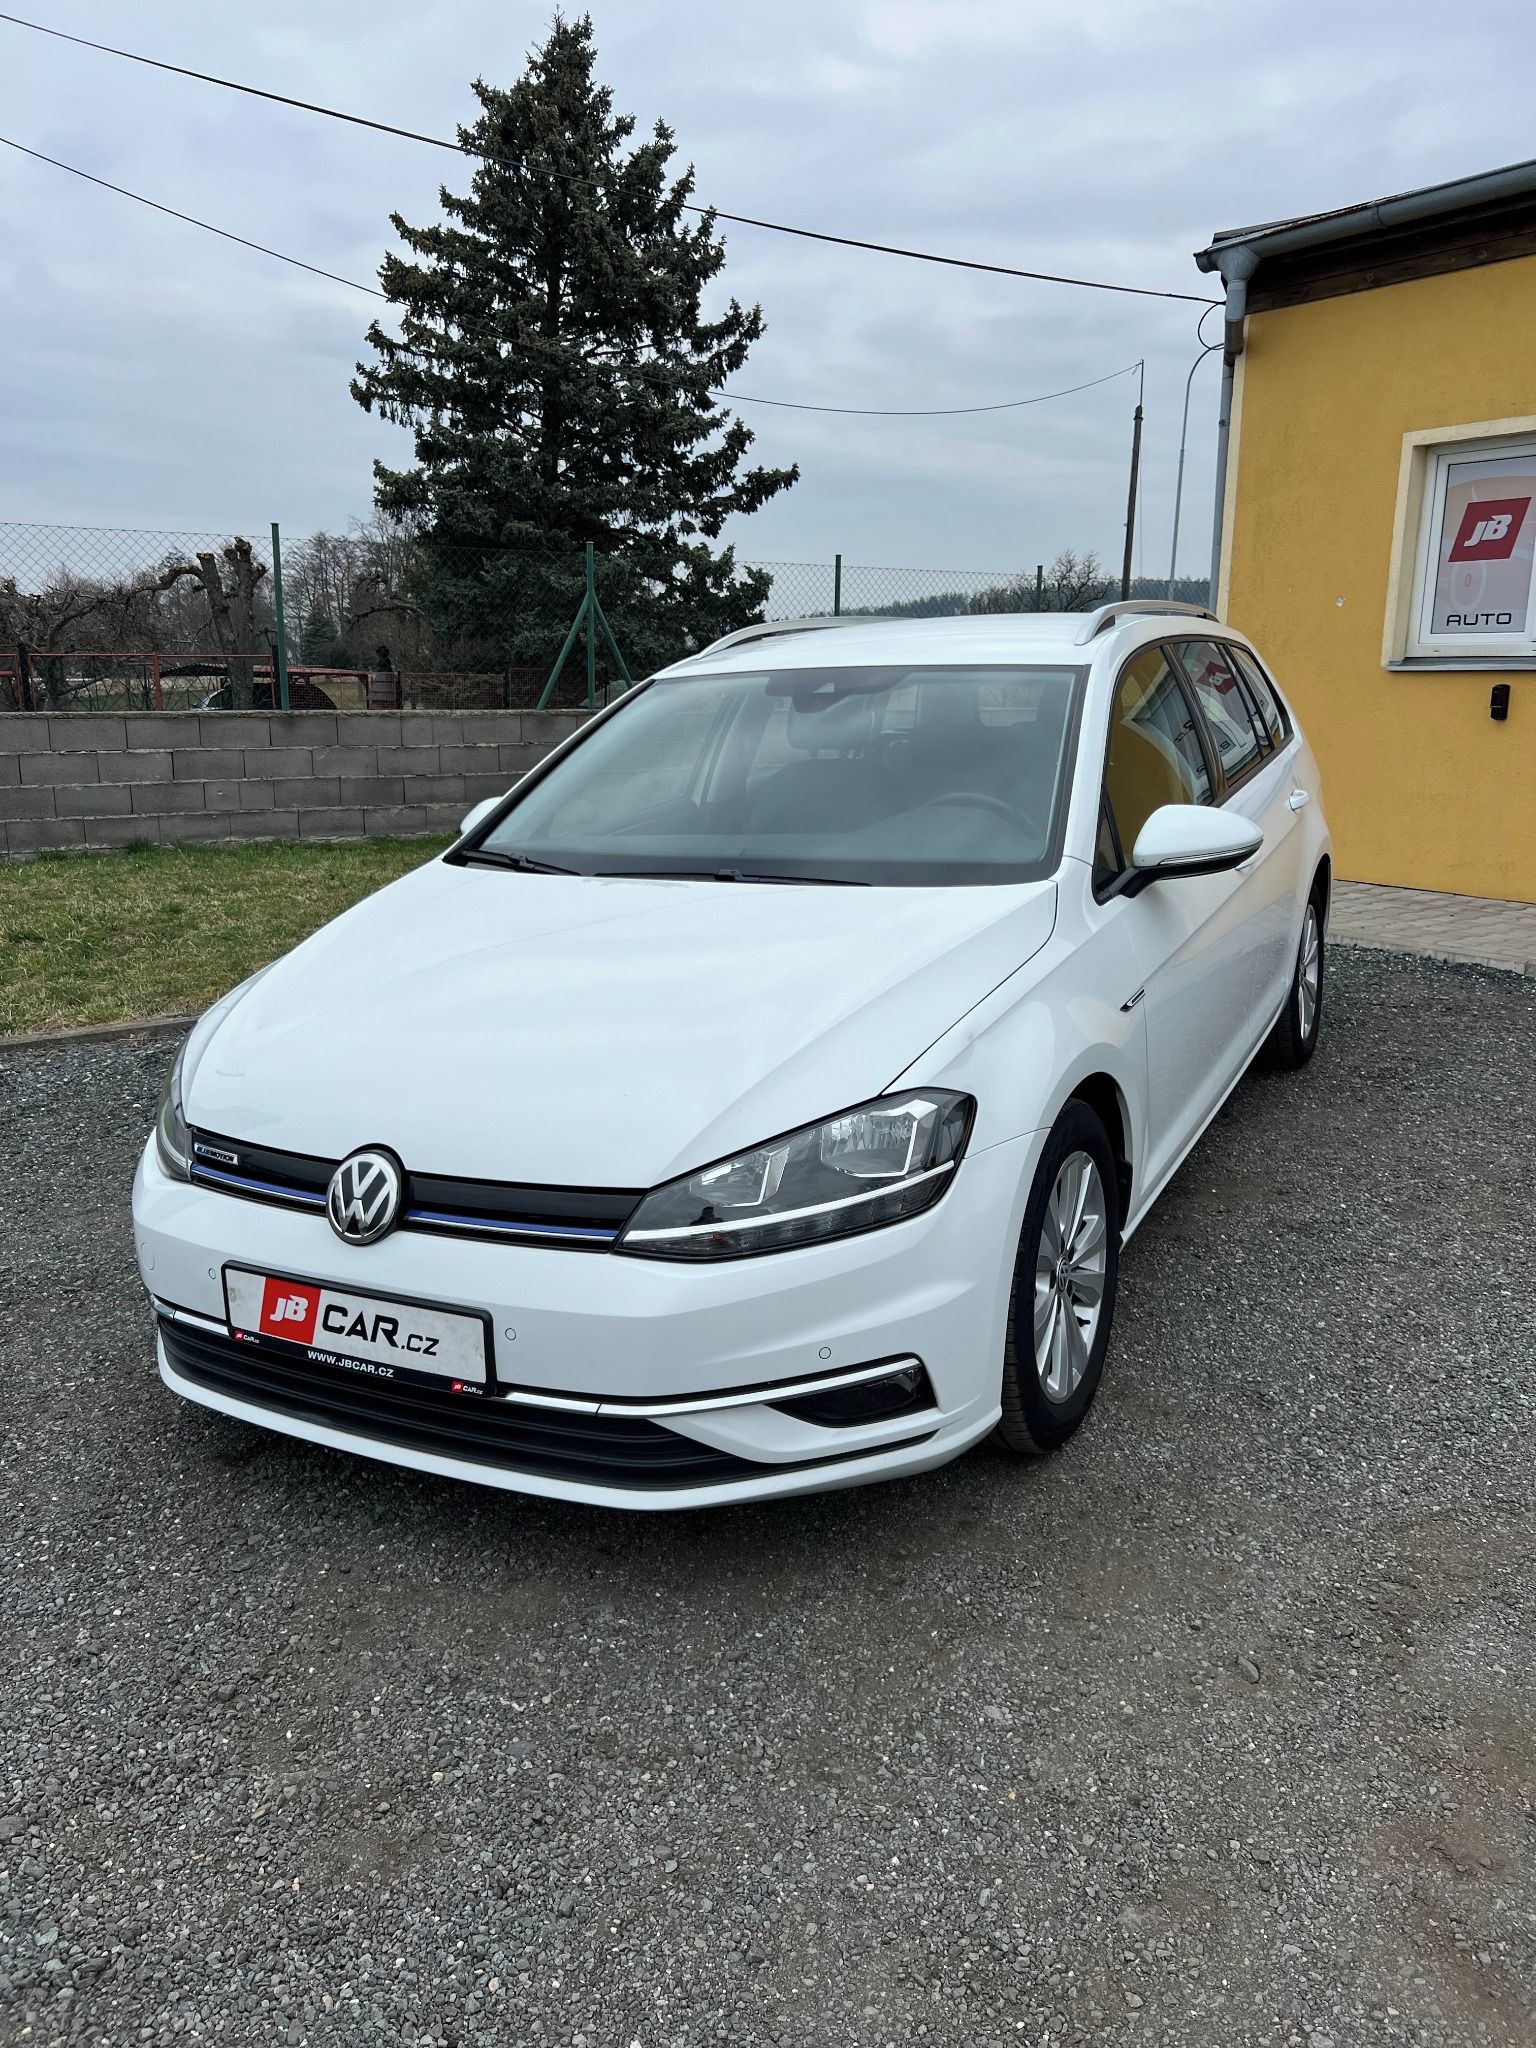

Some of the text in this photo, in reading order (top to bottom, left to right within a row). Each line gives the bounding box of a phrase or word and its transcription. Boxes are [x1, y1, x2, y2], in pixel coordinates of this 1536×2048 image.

[1463, 514, 1513, 547] JB
[1446, 612, 1512, 626] AUTO
[269, 1295, 309, 1322] JB
[307, 1349, 394, 1378] WWW.JBCAR.CZ
